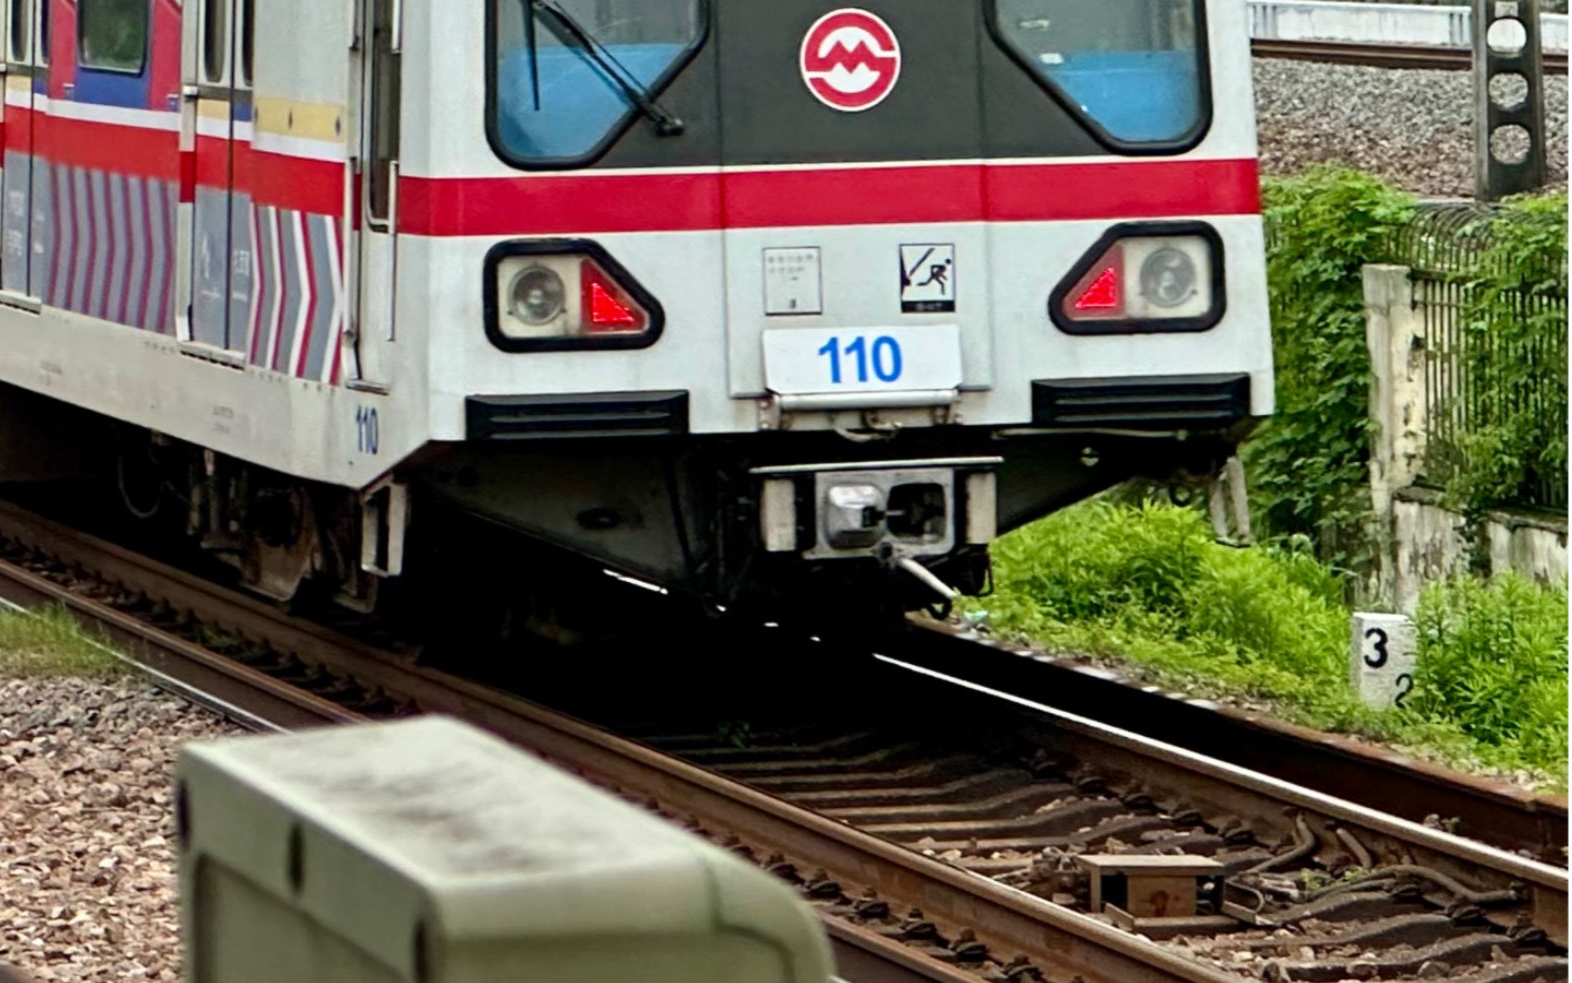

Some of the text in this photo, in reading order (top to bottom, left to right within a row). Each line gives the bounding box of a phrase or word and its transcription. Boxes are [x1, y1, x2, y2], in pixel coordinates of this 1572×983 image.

[818, 335, 903, 384] 110
[356, 405, 379, 455] 110
[1363, 627, 1388, 669] 3
[1394, 673, 1414, 708] 2
